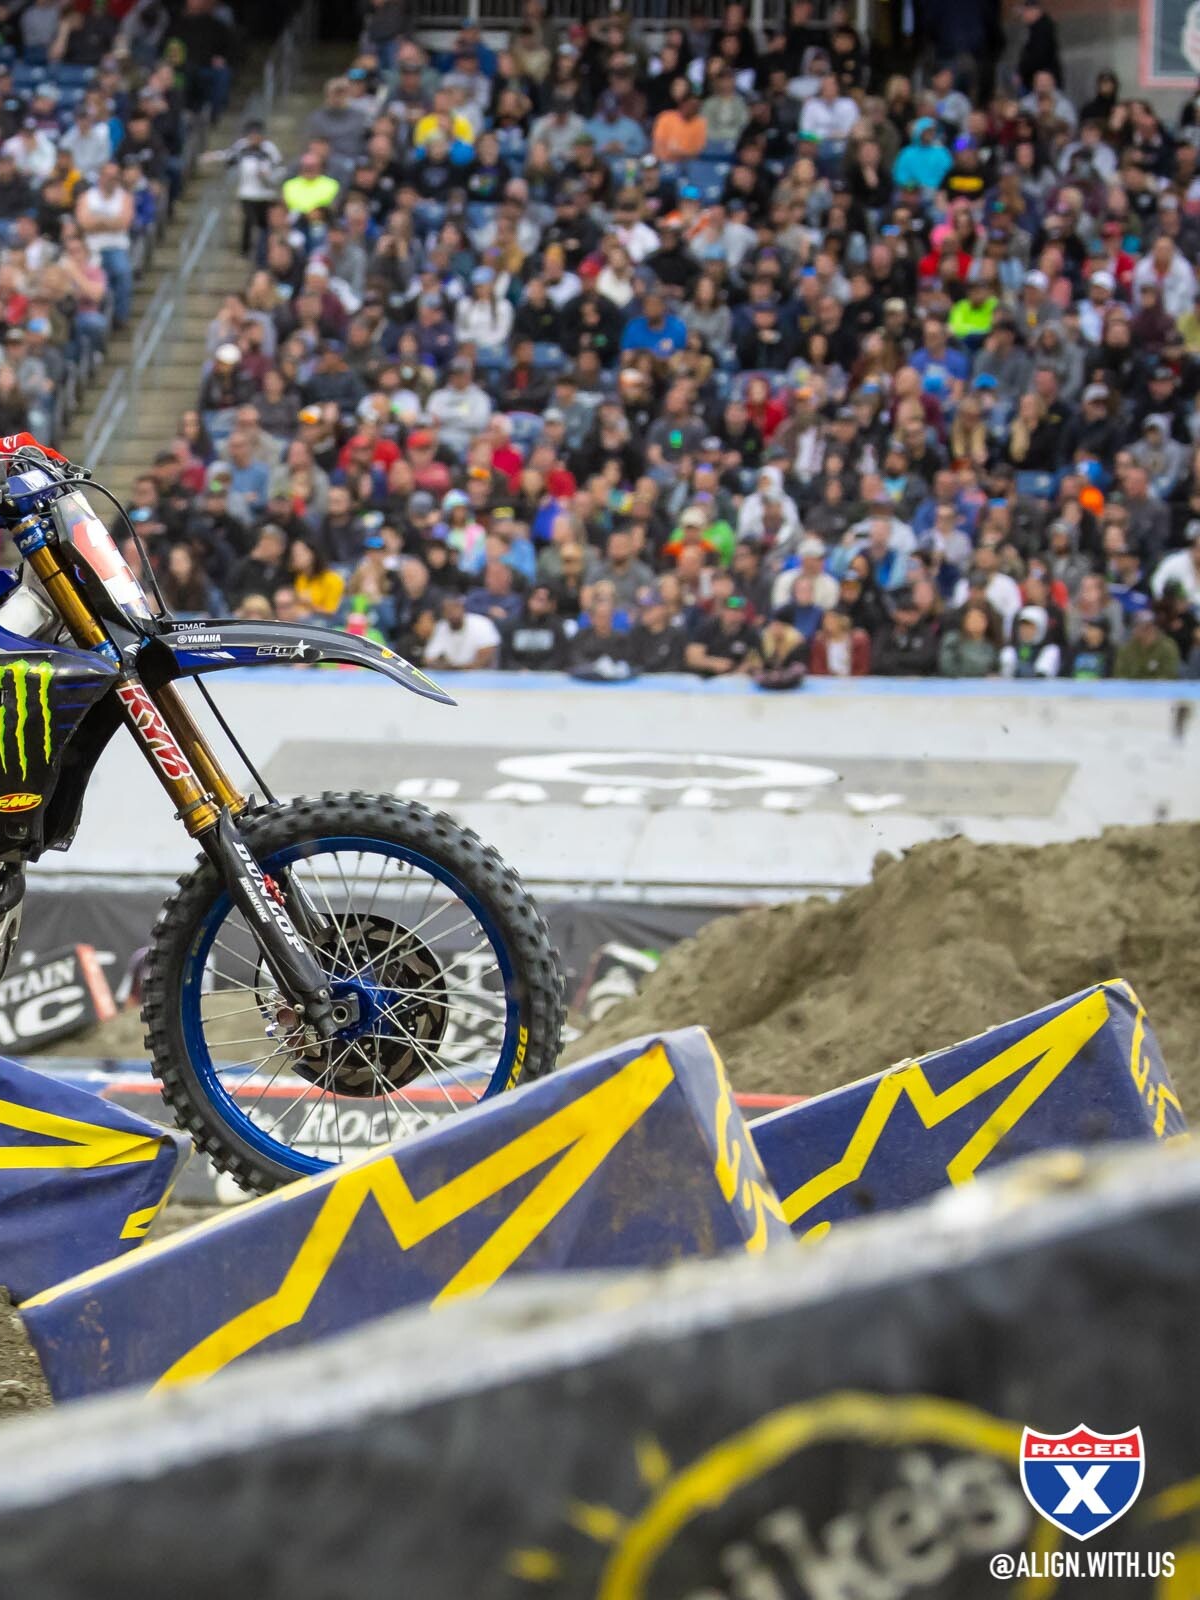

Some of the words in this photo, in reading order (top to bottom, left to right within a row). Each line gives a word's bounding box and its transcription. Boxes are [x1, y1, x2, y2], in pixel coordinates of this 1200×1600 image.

[172, 623, 206, 631] TOMAC
[187, 634, 221, 643] YAMAHA
[116, 684, 193, 780] KYB
[233, 842, 304, 953] DUNLOP
[238, 877, 271, 923] BRAKING
